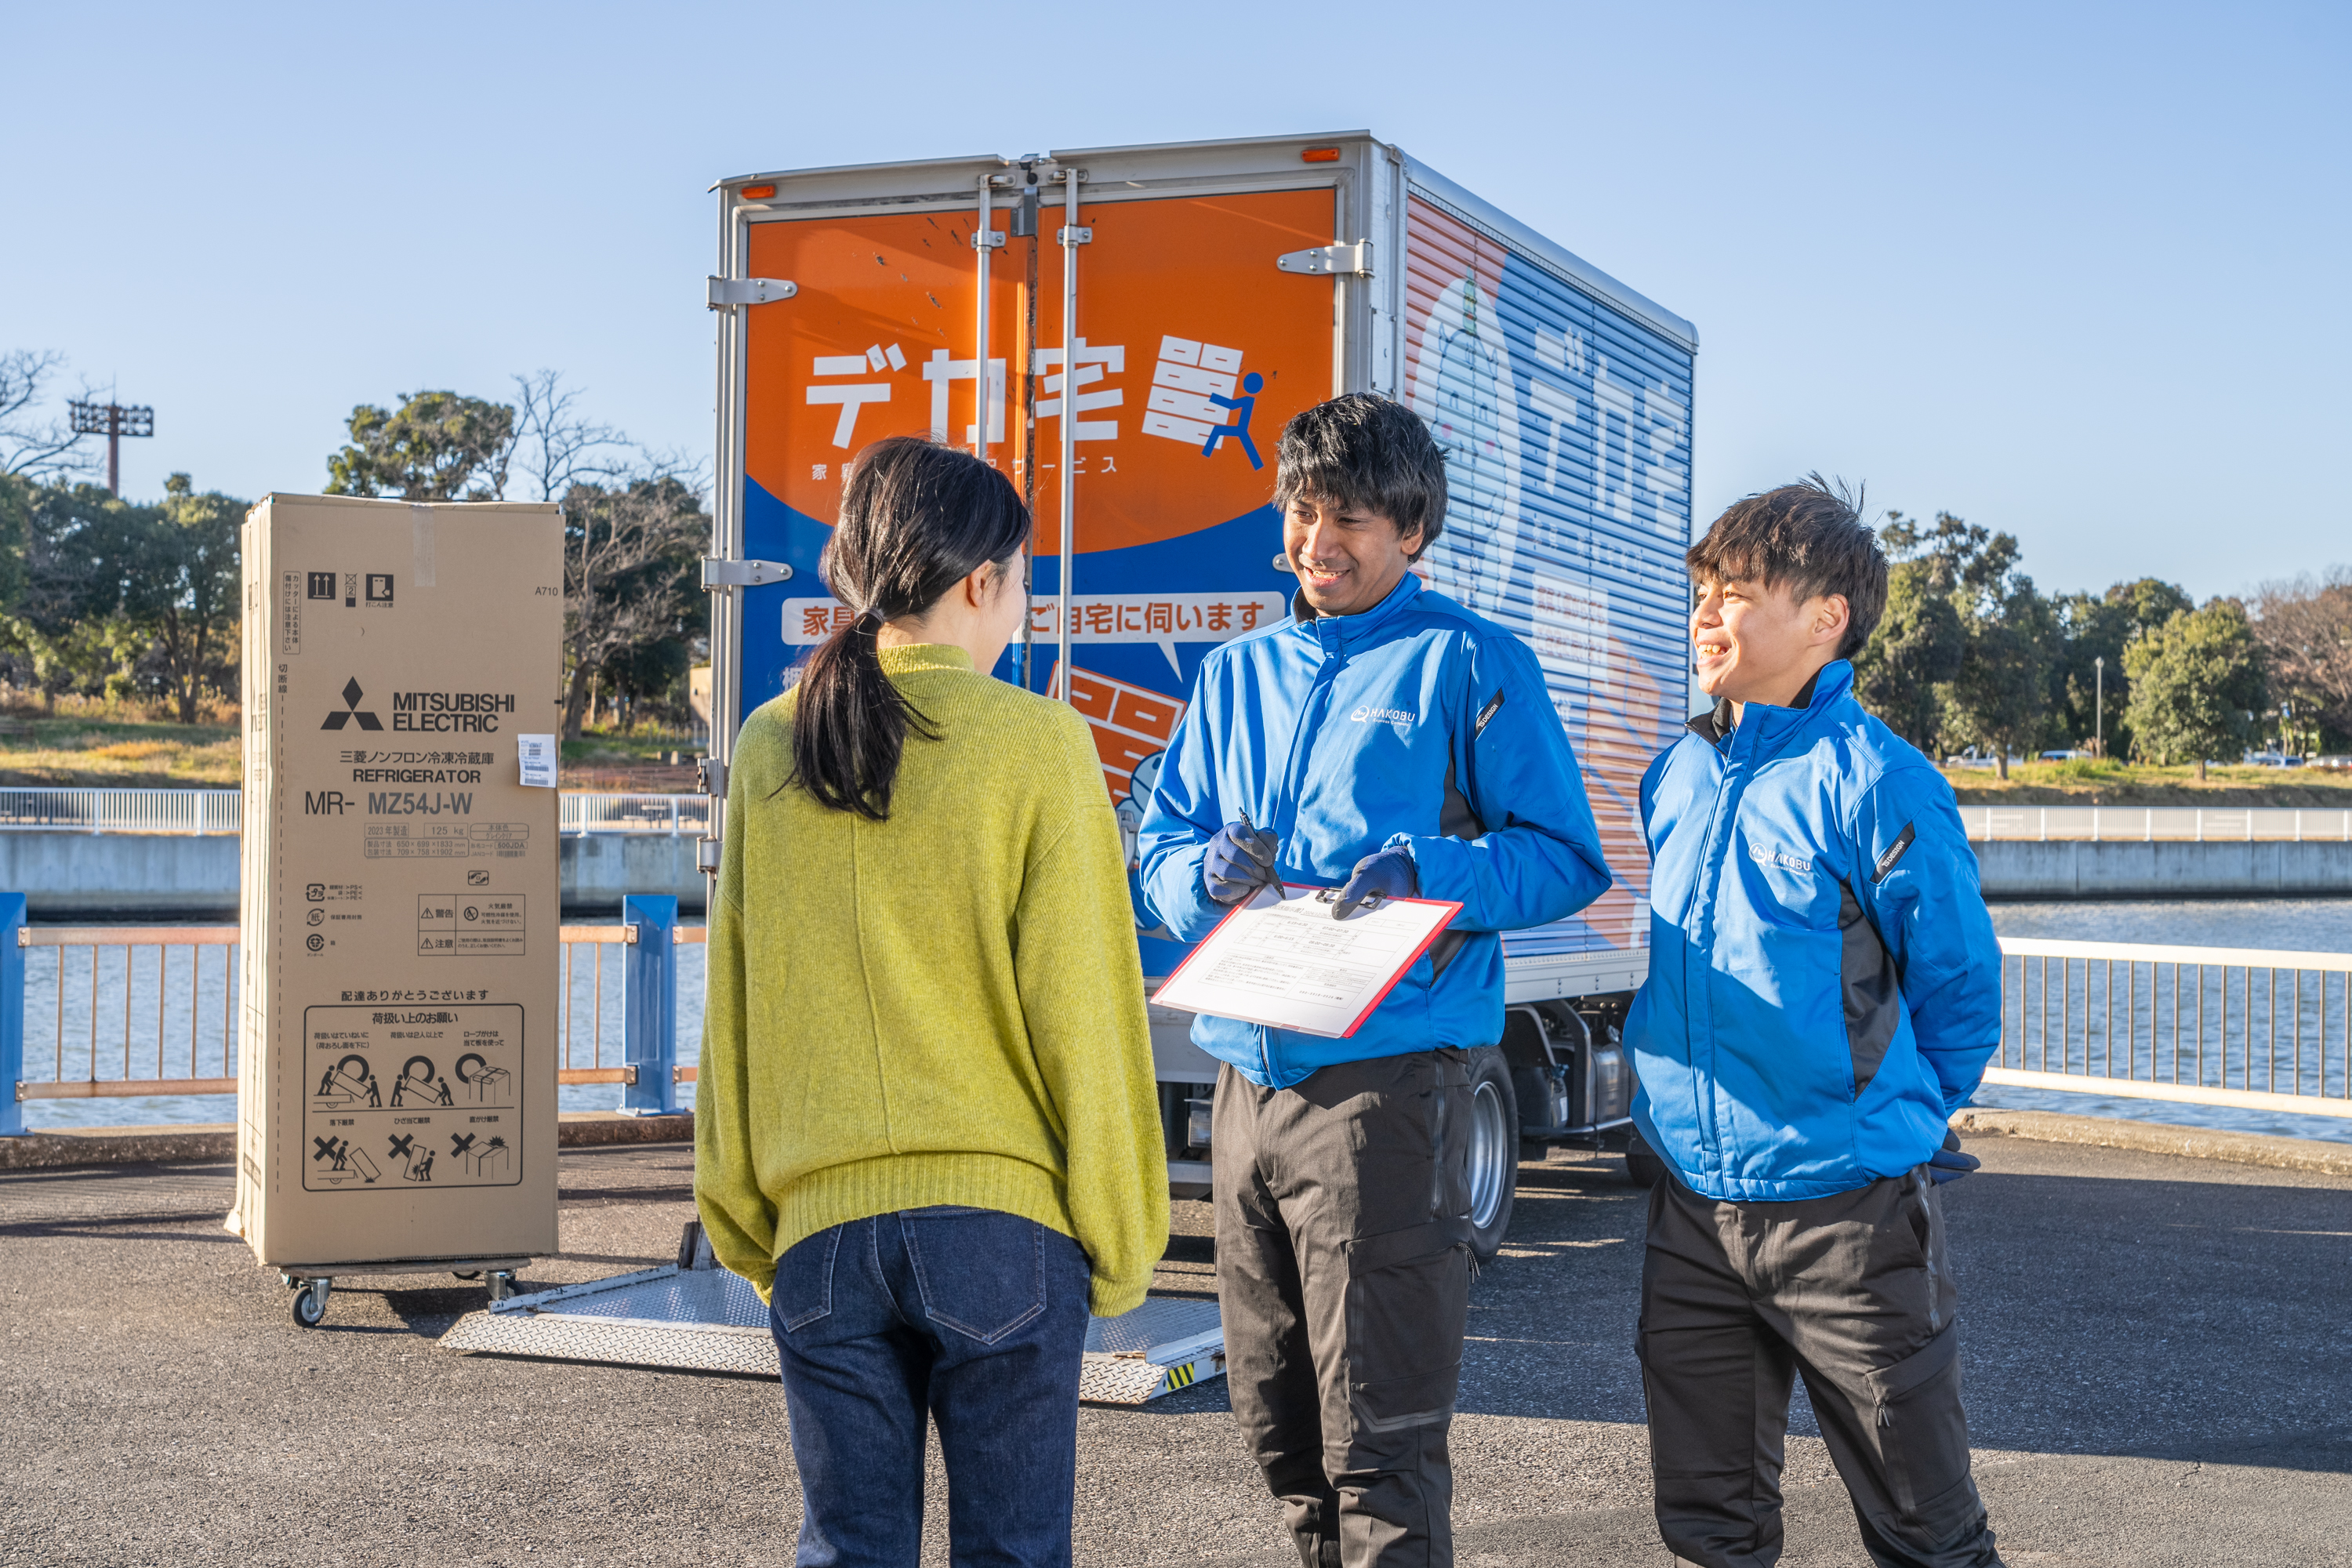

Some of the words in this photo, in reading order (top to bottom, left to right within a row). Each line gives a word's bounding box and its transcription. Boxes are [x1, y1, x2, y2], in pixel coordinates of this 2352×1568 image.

[535, 586, 558, 596] A710
[1030, 601, 1265, 634] ご自宅に伺います
[278, 663, 288, 694] 切断線
[393, 691, 515, 713] MITSUBISHI
[1370, 708, 1415, 721] HAKOBU
[393, 712, 499, 733] ELECTRIC
[339, 750, 495, 765] 三菱ノンフロン冷凍冷蔵庫
[353, 769, 481, 784] REFRIGERATOR
[305, 791, 355, 815] MR-
[368, 792, 473, 815] MZ54J-W
[431, 826, 448, 836] 125
[453, 827, 464, 836] kg
[1767, 850, 1811, 871] HAKOBU
[310, 913, 321, 922] 紙
[435, 909, 454, 918] 警告
[434, 938, 454, 949] 注意
[341, 989, 489, 1002] 配達ありがとうございます
[372, 1011, 459, 1025] 荷扱い上のお願い
[314, 1031, 369, 1040] 荷扱いはていねいに
[390, 1031, 444, 1040] 荷扱いは2人以上で
[329, 1118, 355, 1127] 落下厳禁
[394, 1116, 431, 1125] ひざ当て厳禁
[469, 1115, 499, 1123] 直がけ厳禁
